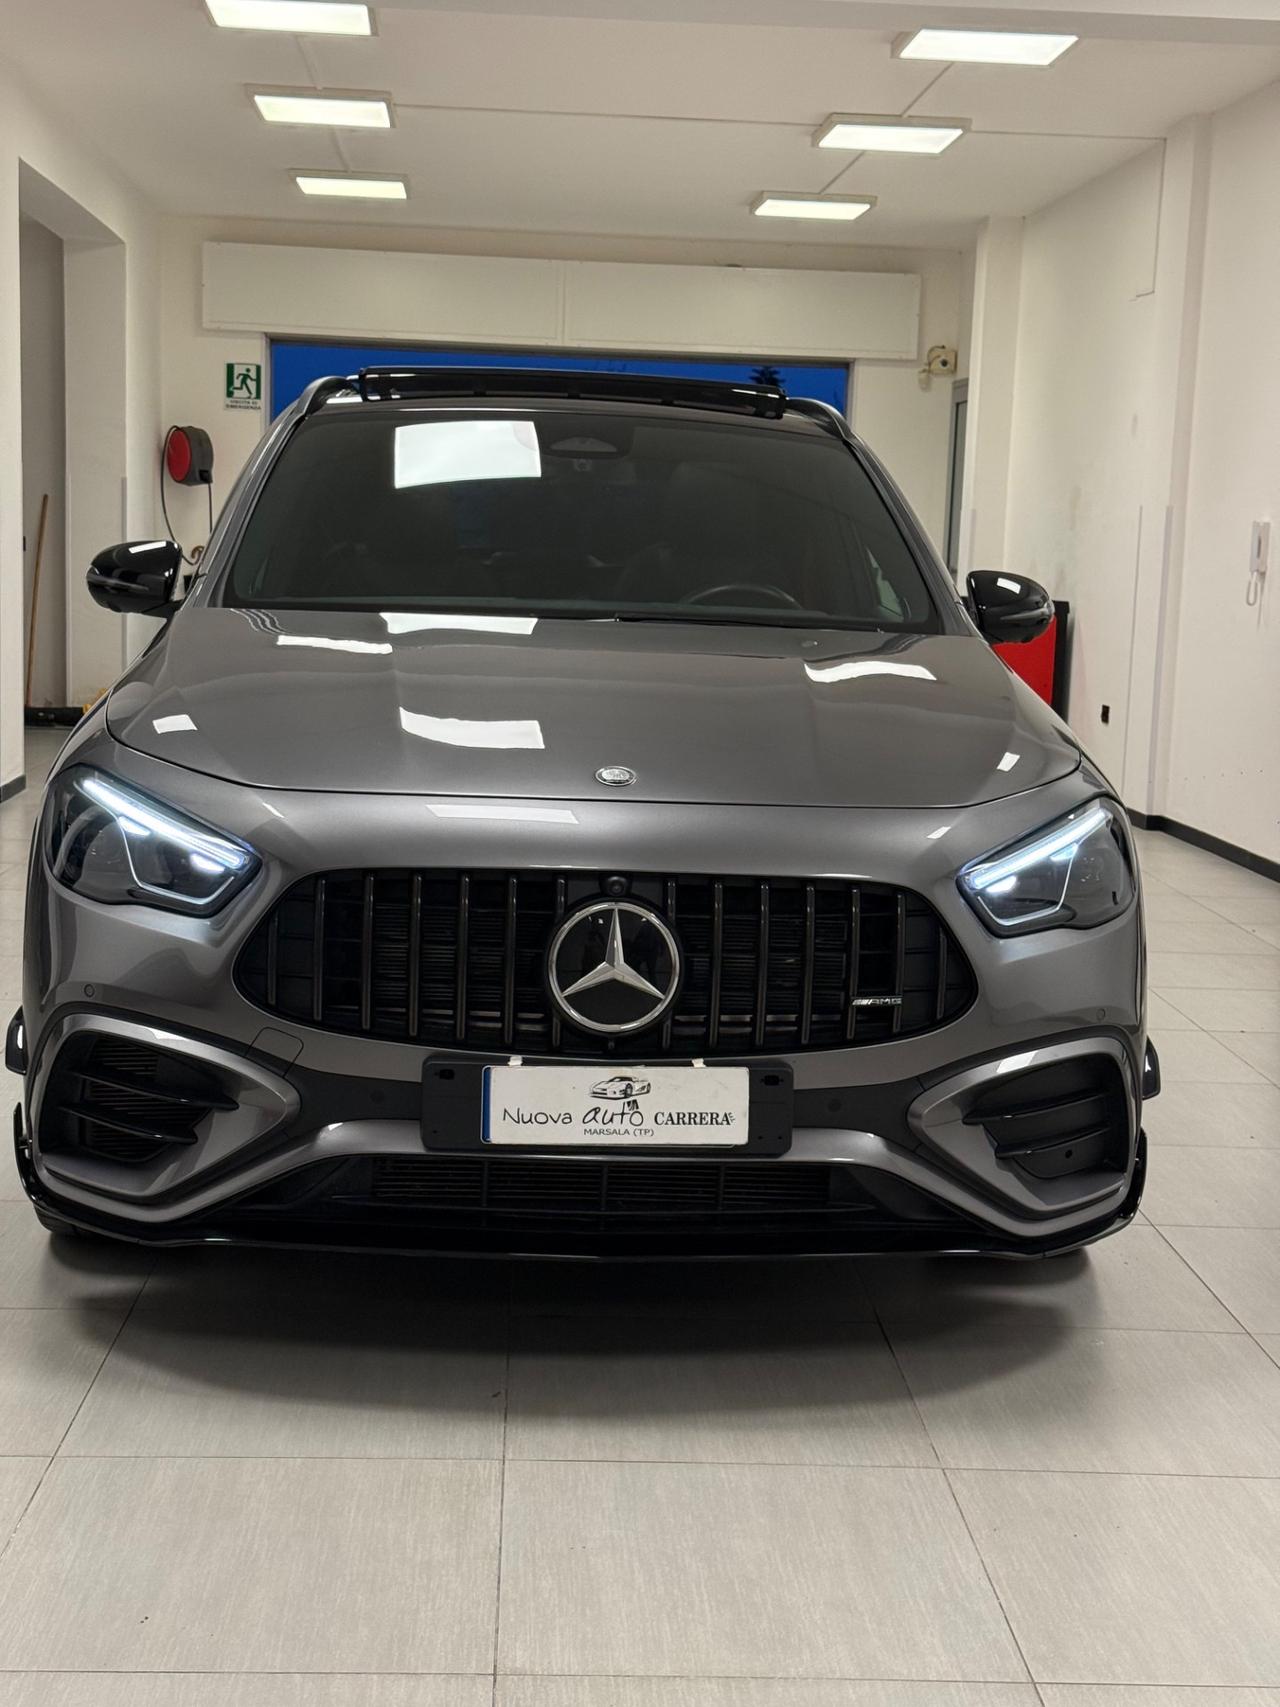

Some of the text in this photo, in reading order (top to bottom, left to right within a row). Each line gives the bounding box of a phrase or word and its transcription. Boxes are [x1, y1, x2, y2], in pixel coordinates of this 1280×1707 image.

[503, 1107, 573, 1125] Nuova
[654, 1111, 731, 1126] CARRERA
[583, 1128, 655, 1137] MARSALA (TP)
